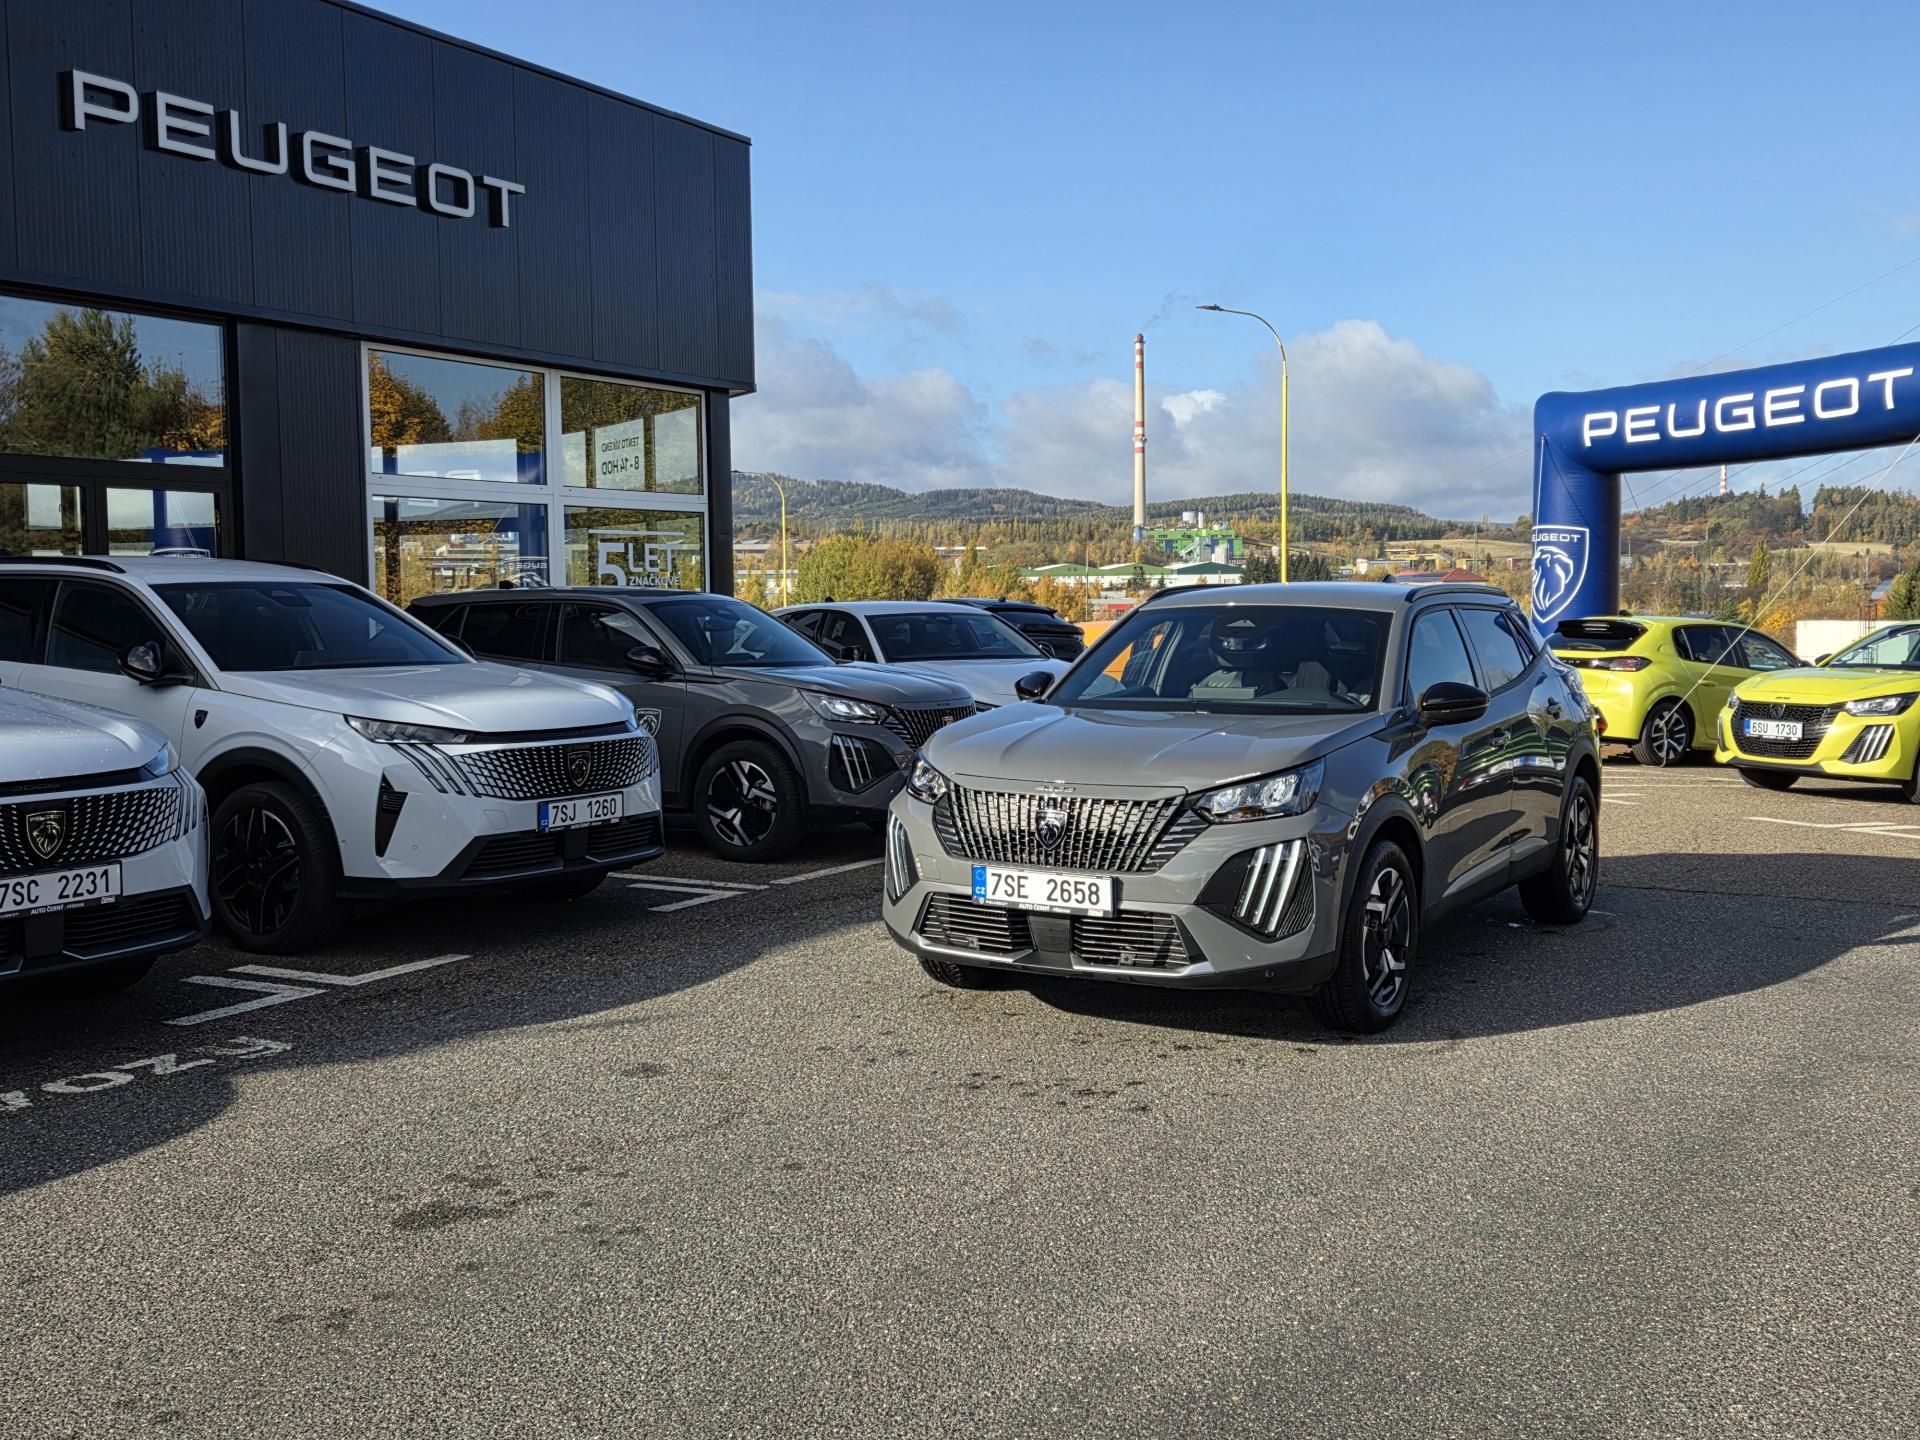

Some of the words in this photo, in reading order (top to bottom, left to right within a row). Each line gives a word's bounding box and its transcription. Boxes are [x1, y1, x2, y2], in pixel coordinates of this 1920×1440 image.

[70, 68, 526, 228] PEUGEOT
[1583, 366, 1914, 447] PEUGEOT
[598, 541, 627, 588] 5
[628, 543, 680, 573] LET
[1752, 722, 1769, 734] 6SU
[1775, 723, 1798, 736] 1730
[552, 803, 576, 824] 7SJ
[587, 798, 617, 819] 1260
[0, 879, 40, 909] 7SC
[58, 868, 110, 900] 2231
[975, 886, 986, 895] CZ
[991, 872, 1029, 899] 7SE
[1046, 878, 1100, 906] 2658
